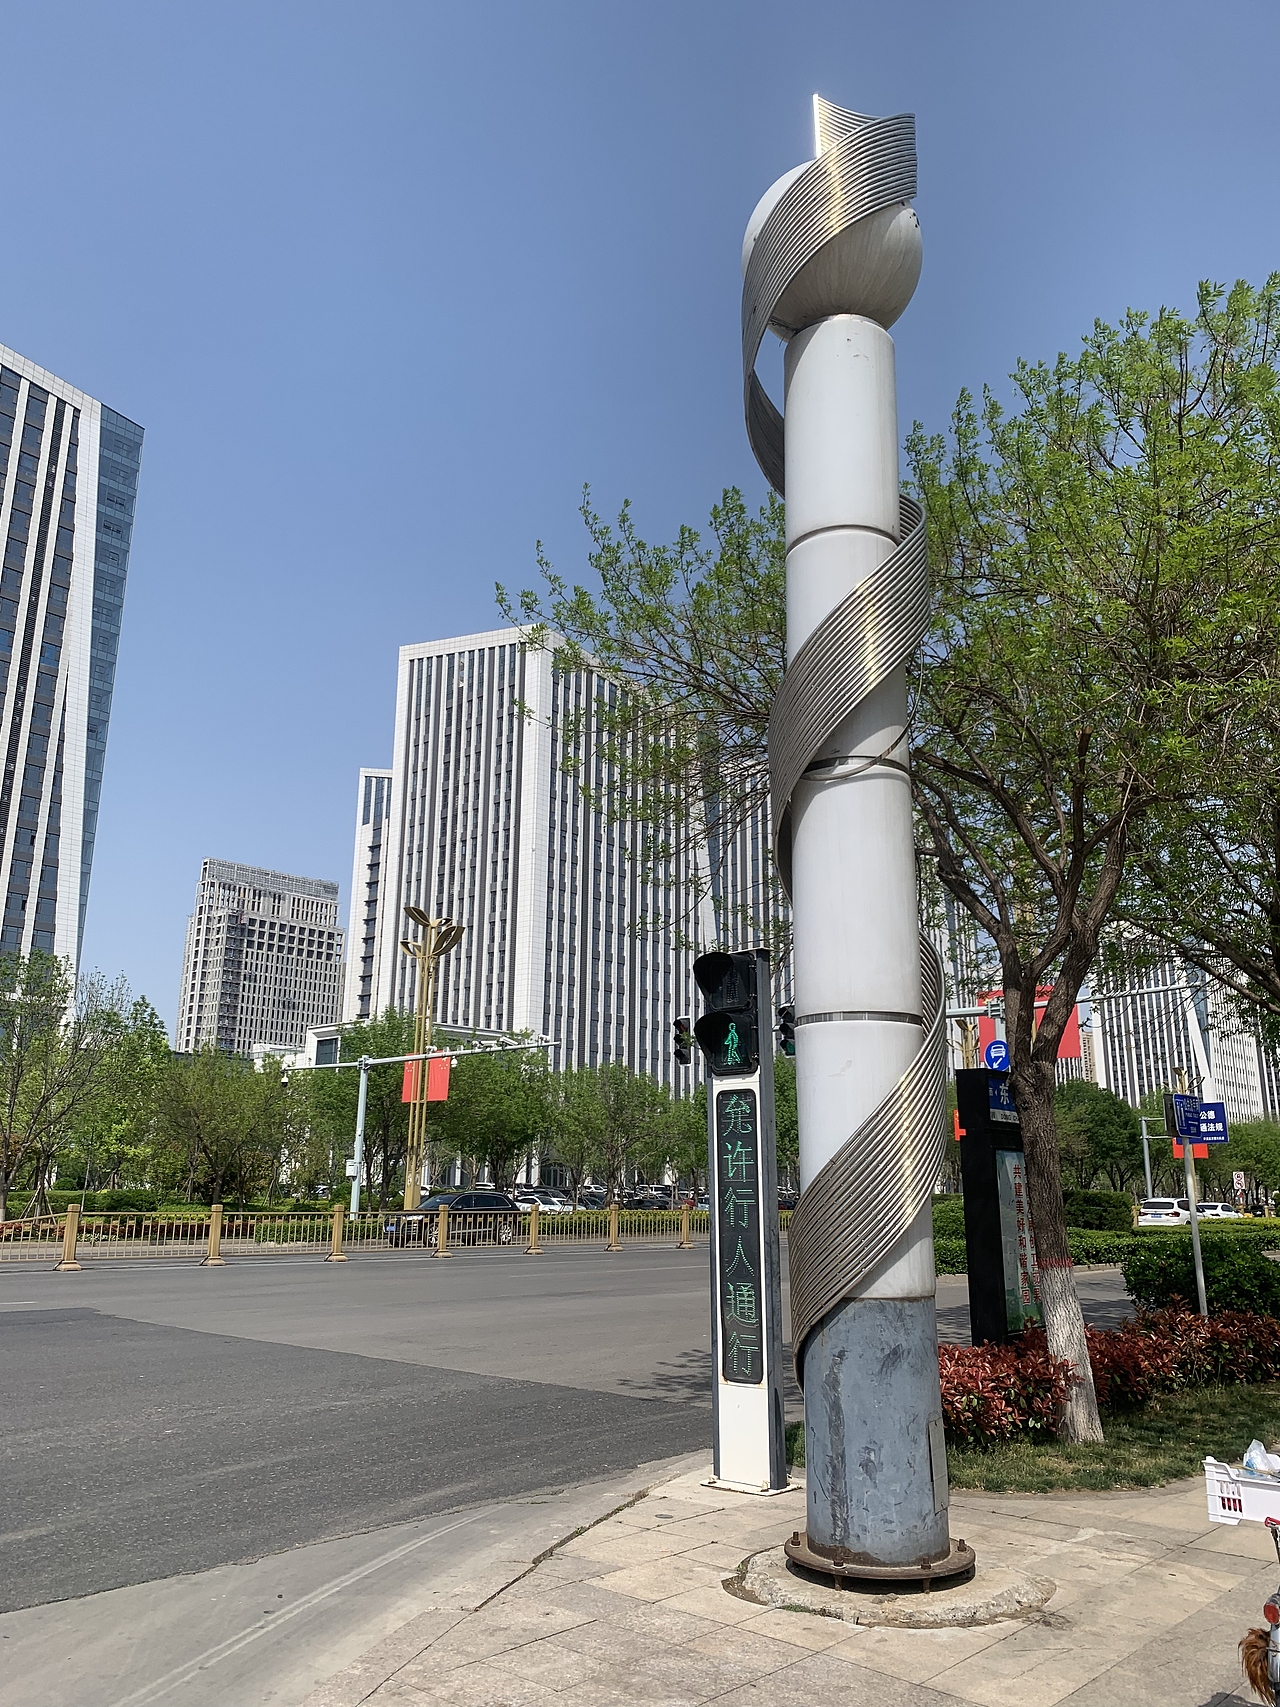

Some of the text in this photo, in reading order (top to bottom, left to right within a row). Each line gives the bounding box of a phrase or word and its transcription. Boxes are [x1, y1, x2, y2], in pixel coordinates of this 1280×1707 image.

[999, 1083, 1010, 1105] 东
[1200, 1111, 1215, 1120] 公德
[722, 1094, 759, 1376] 允许行人通行
[1013, 1164, 1031, 1305] 共建美好和谐家园
